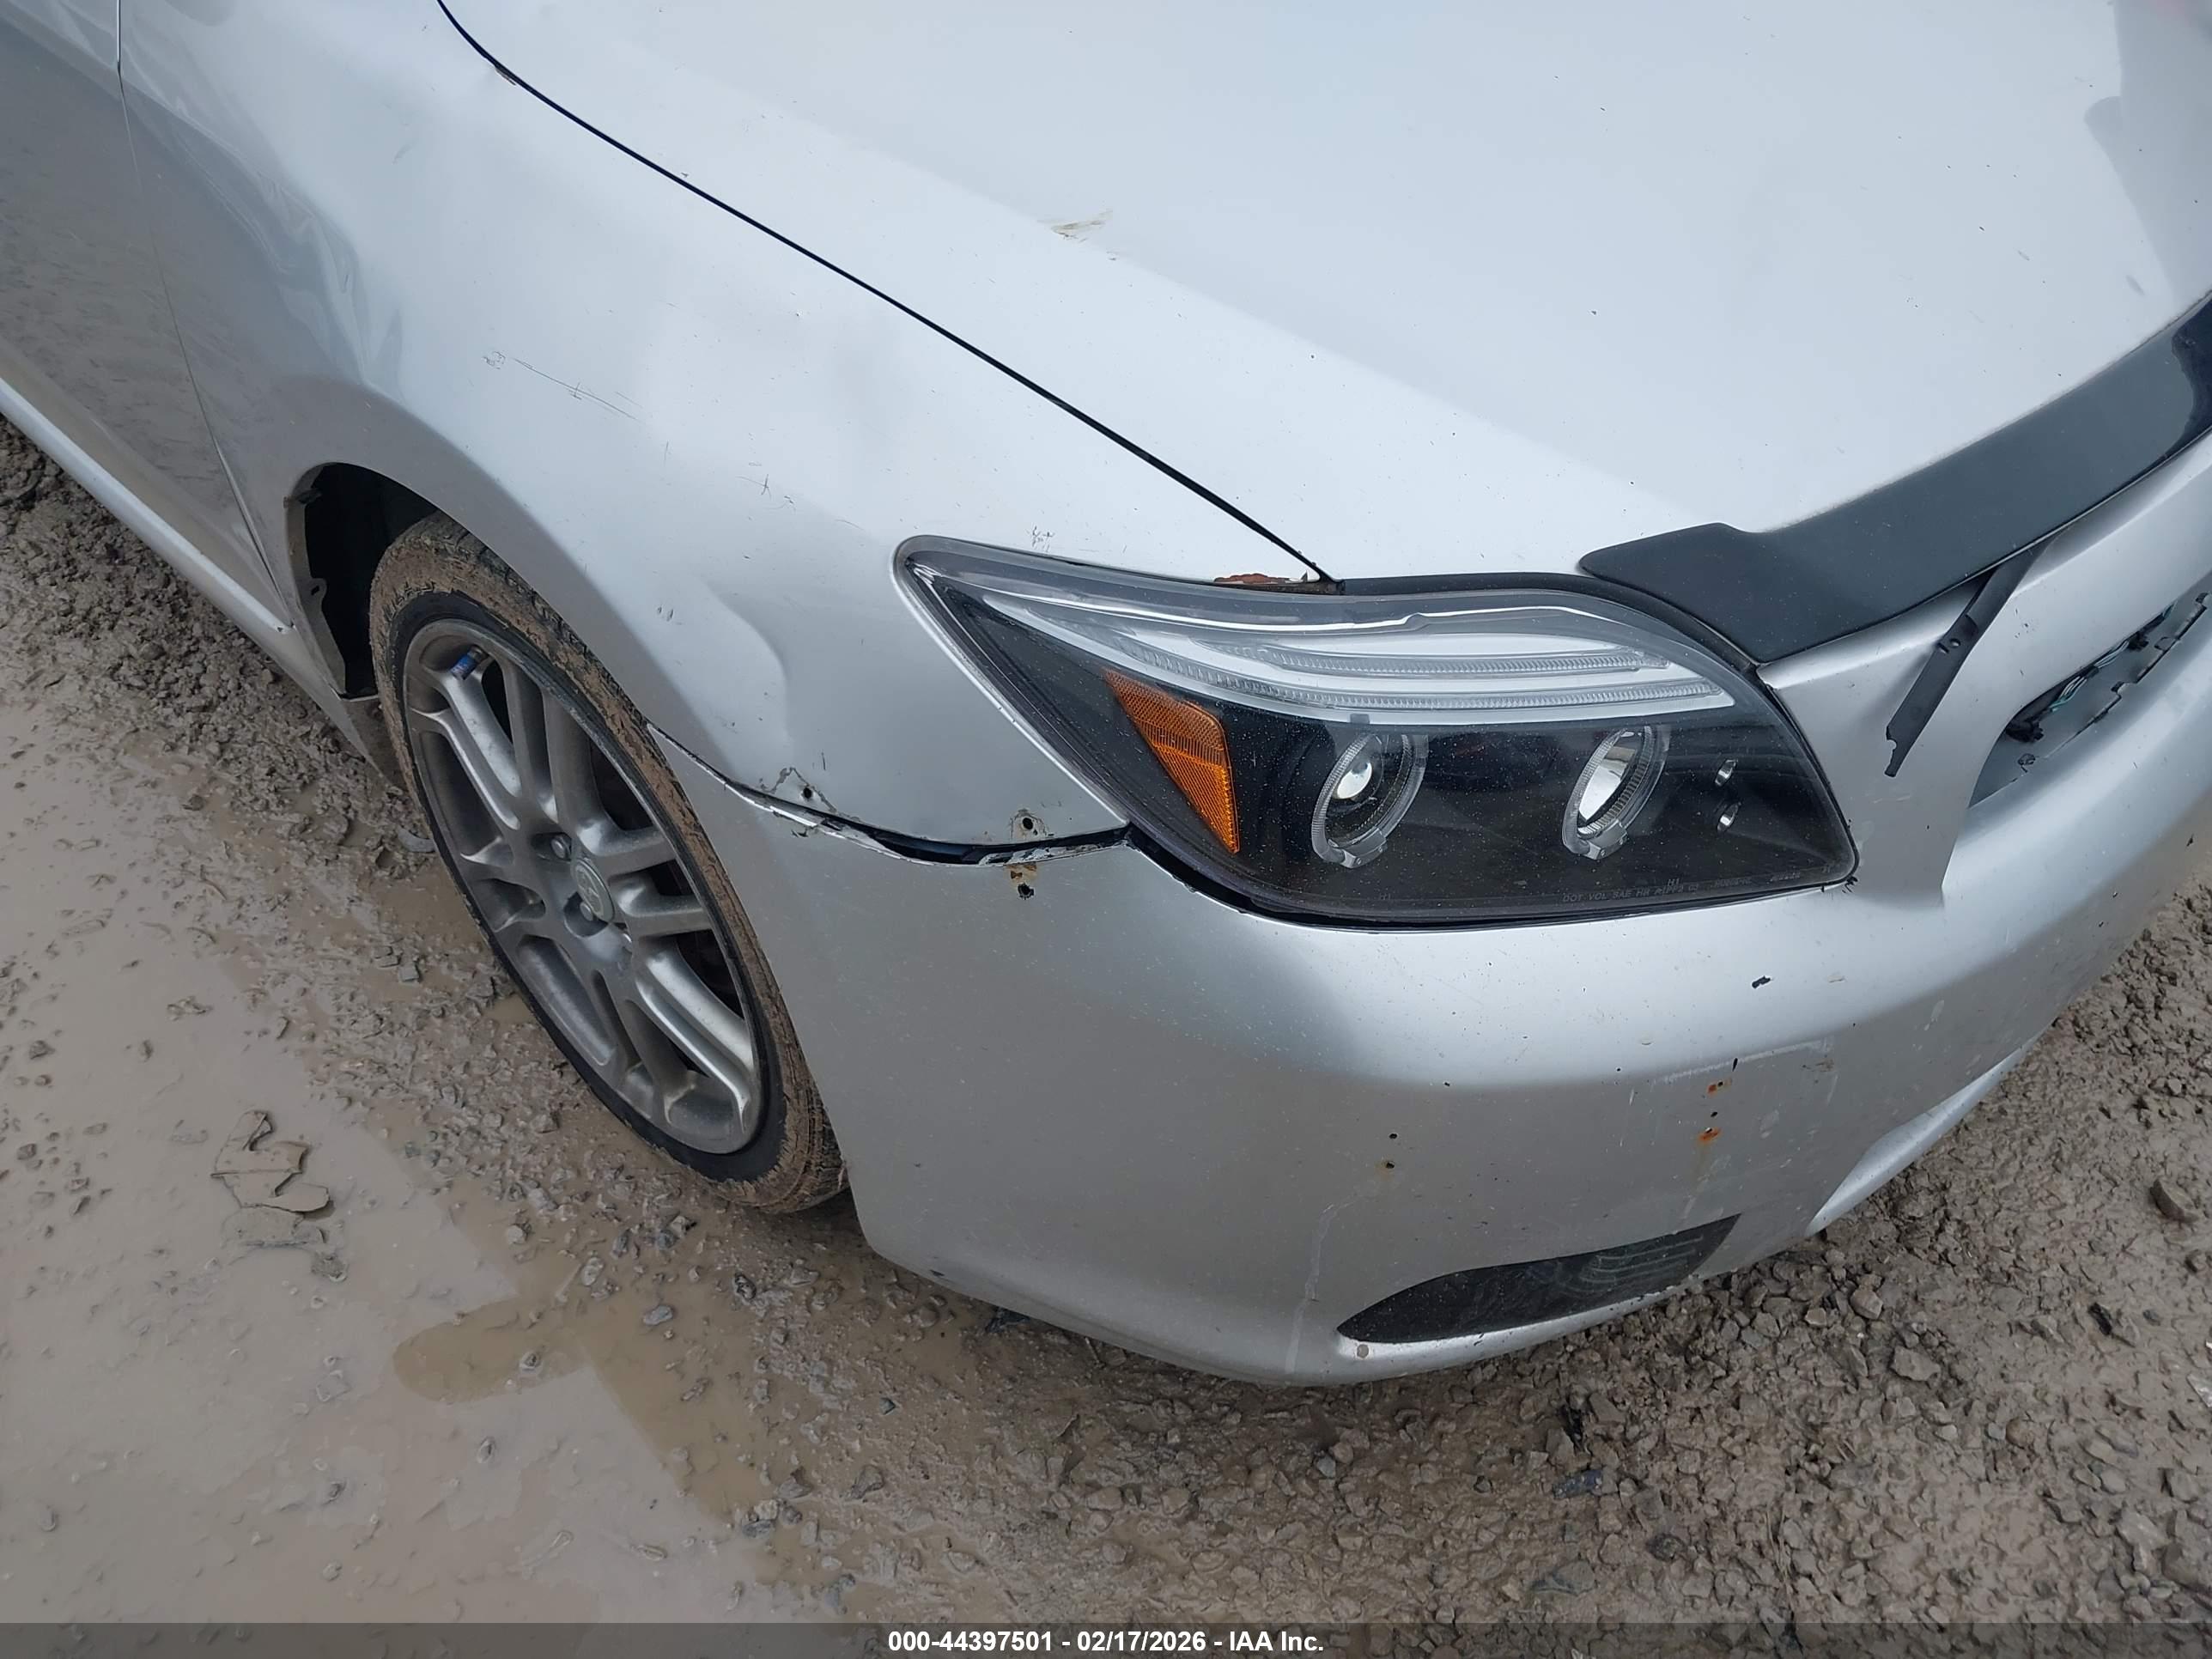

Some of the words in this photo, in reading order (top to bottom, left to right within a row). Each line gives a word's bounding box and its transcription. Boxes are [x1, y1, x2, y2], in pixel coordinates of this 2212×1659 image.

[1562, 892, 1583, 902] DOT
[1589, 891, 1607, 901] VOL
[1613, 890, 1632, 900] SAE
